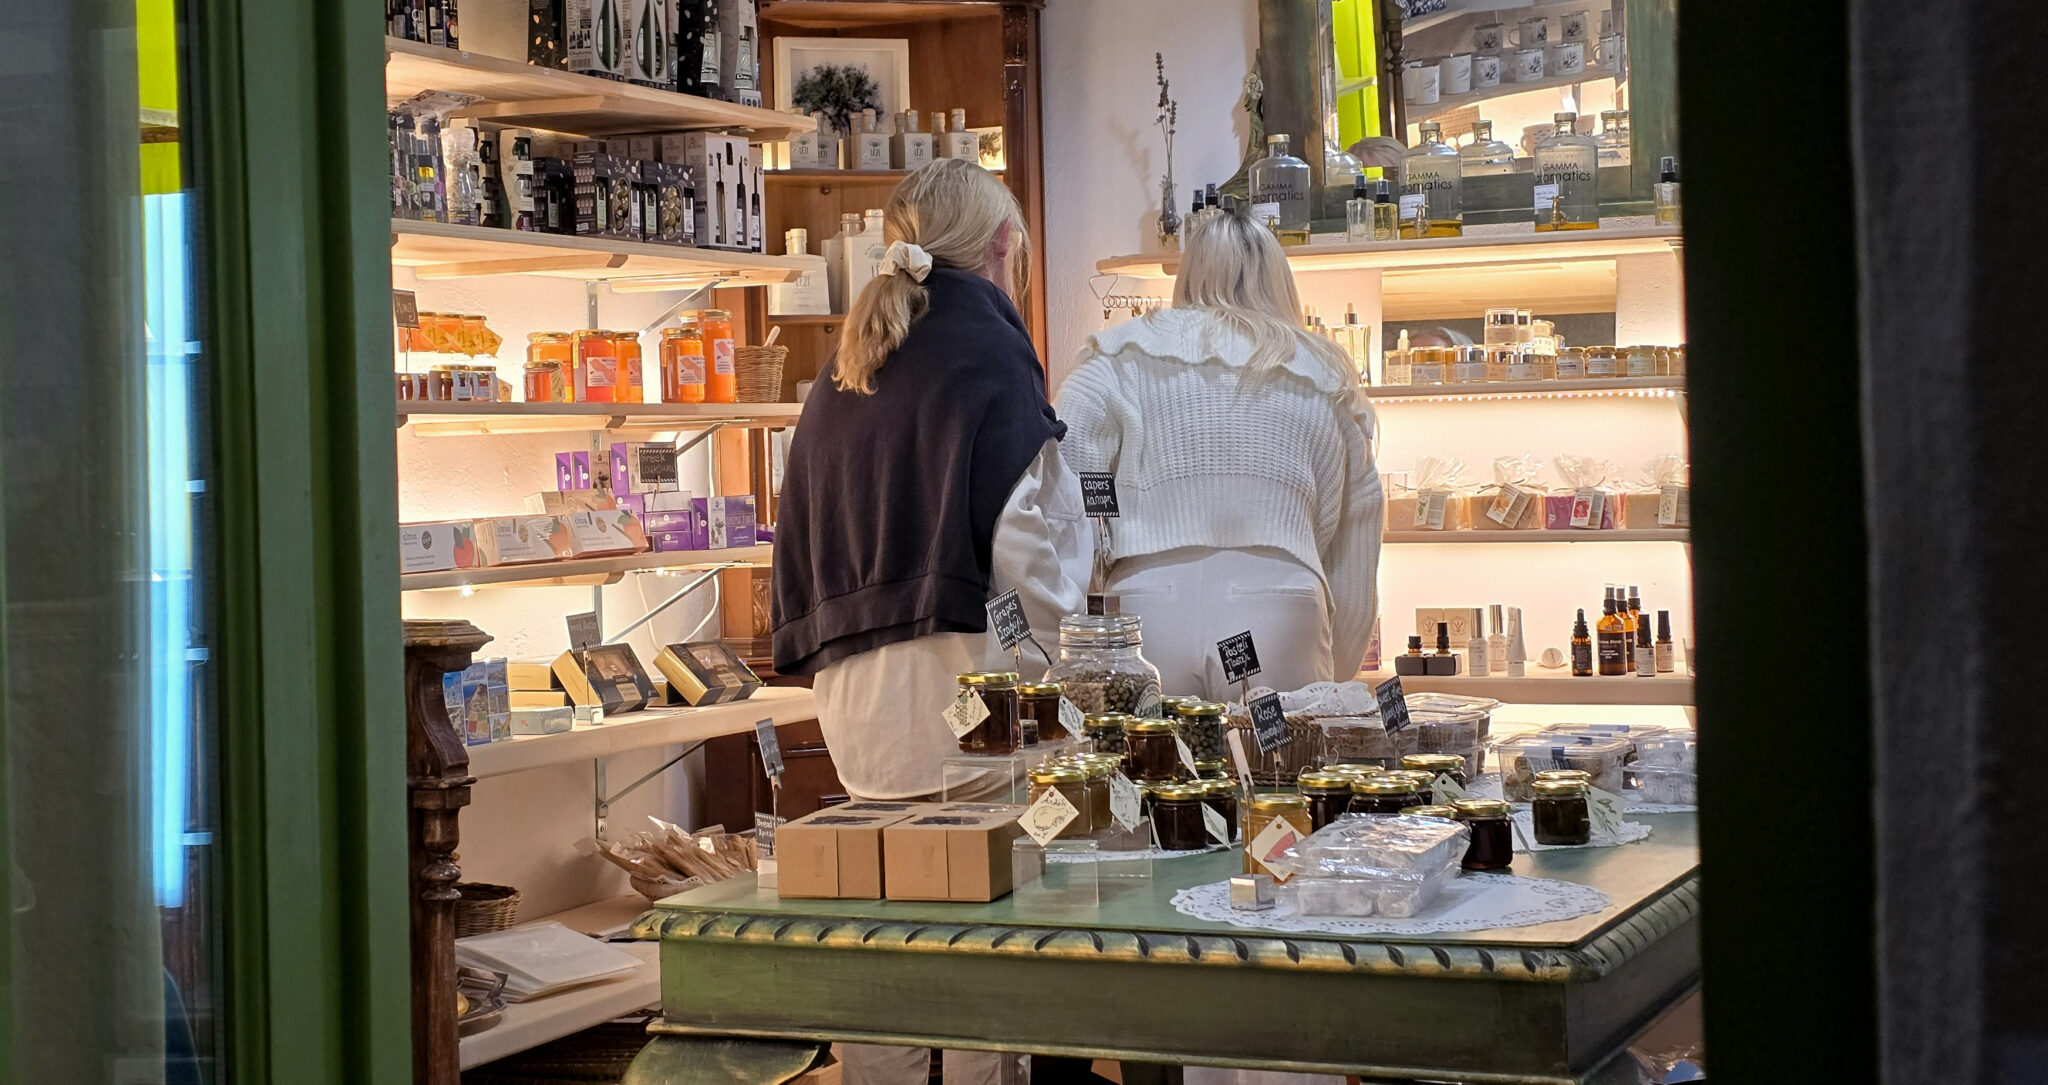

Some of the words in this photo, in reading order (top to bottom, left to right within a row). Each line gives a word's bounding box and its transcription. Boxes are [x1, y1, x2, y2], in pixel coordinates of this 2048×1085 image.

[1542, 162, 1579, 172] GAMMA
[1405, 170, 1440, 181] GAMMA
[1259, 183, 1293, 192] GAMMA
[1083, 480, 1110, 495] capers
[993, 599, 1018, 625] Grapes
[1254, 704, 1278, 723] Rose
